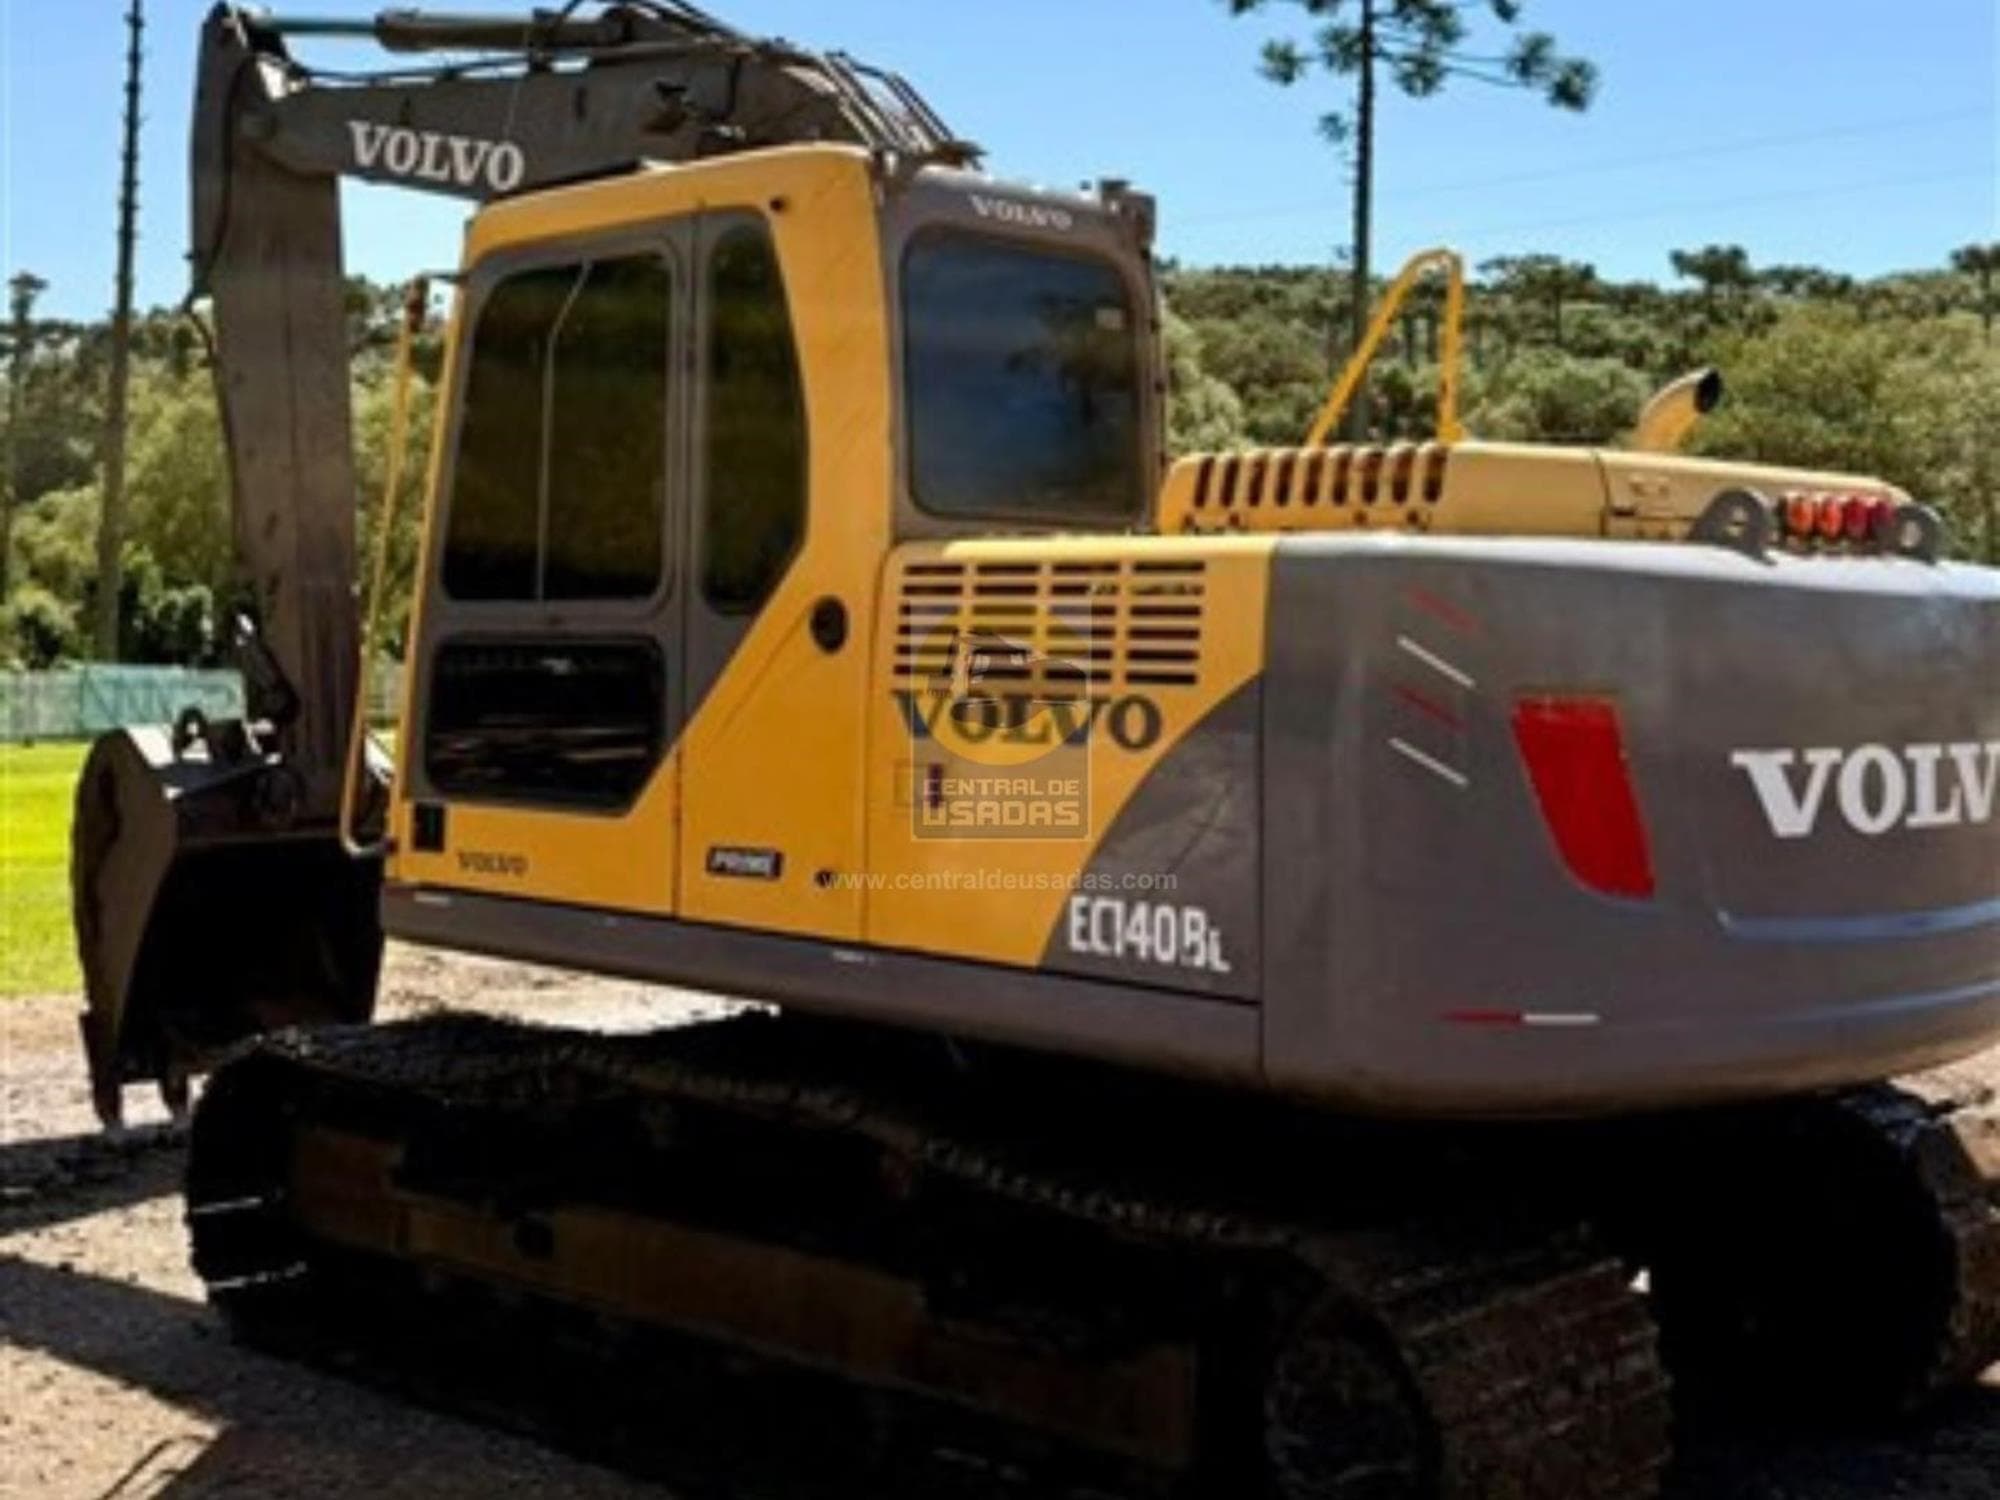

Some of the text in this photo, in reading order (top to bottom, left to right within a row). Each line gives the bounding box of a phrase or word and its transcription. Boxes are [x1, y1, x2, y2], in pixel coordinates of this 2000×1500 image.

[349, 121, 525, 191] VOLVO
[970, 193, 1073, 231] VOLVO
[890, 689, 1163, 751] VOLVO
[1731, 743, 2000, 839] VOLV
